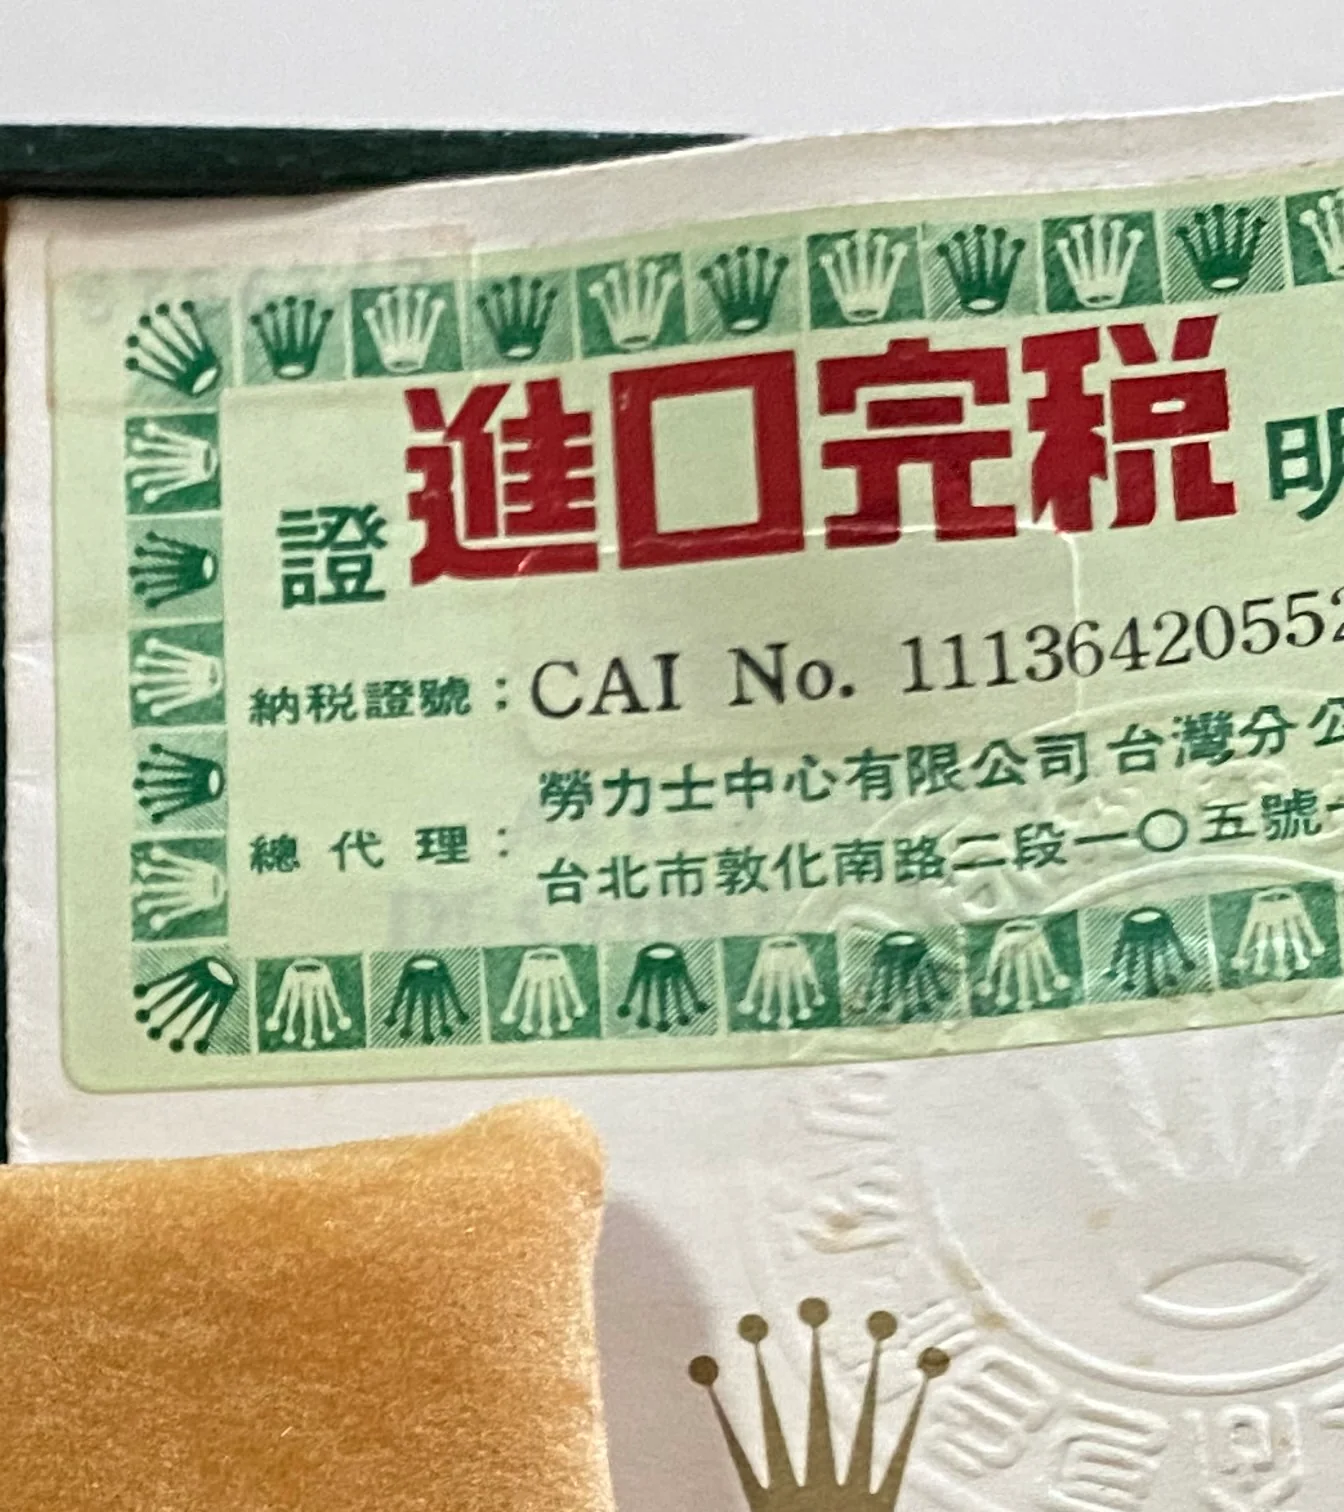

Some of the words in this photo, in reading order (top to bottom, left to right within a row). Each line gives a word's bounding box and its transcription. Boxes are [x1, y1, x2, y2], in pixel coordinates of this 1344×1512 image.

[277, 504, 387, 609] 證
[529, 652, 683, 720] CAI
[727, 641, 857, 707] No.
